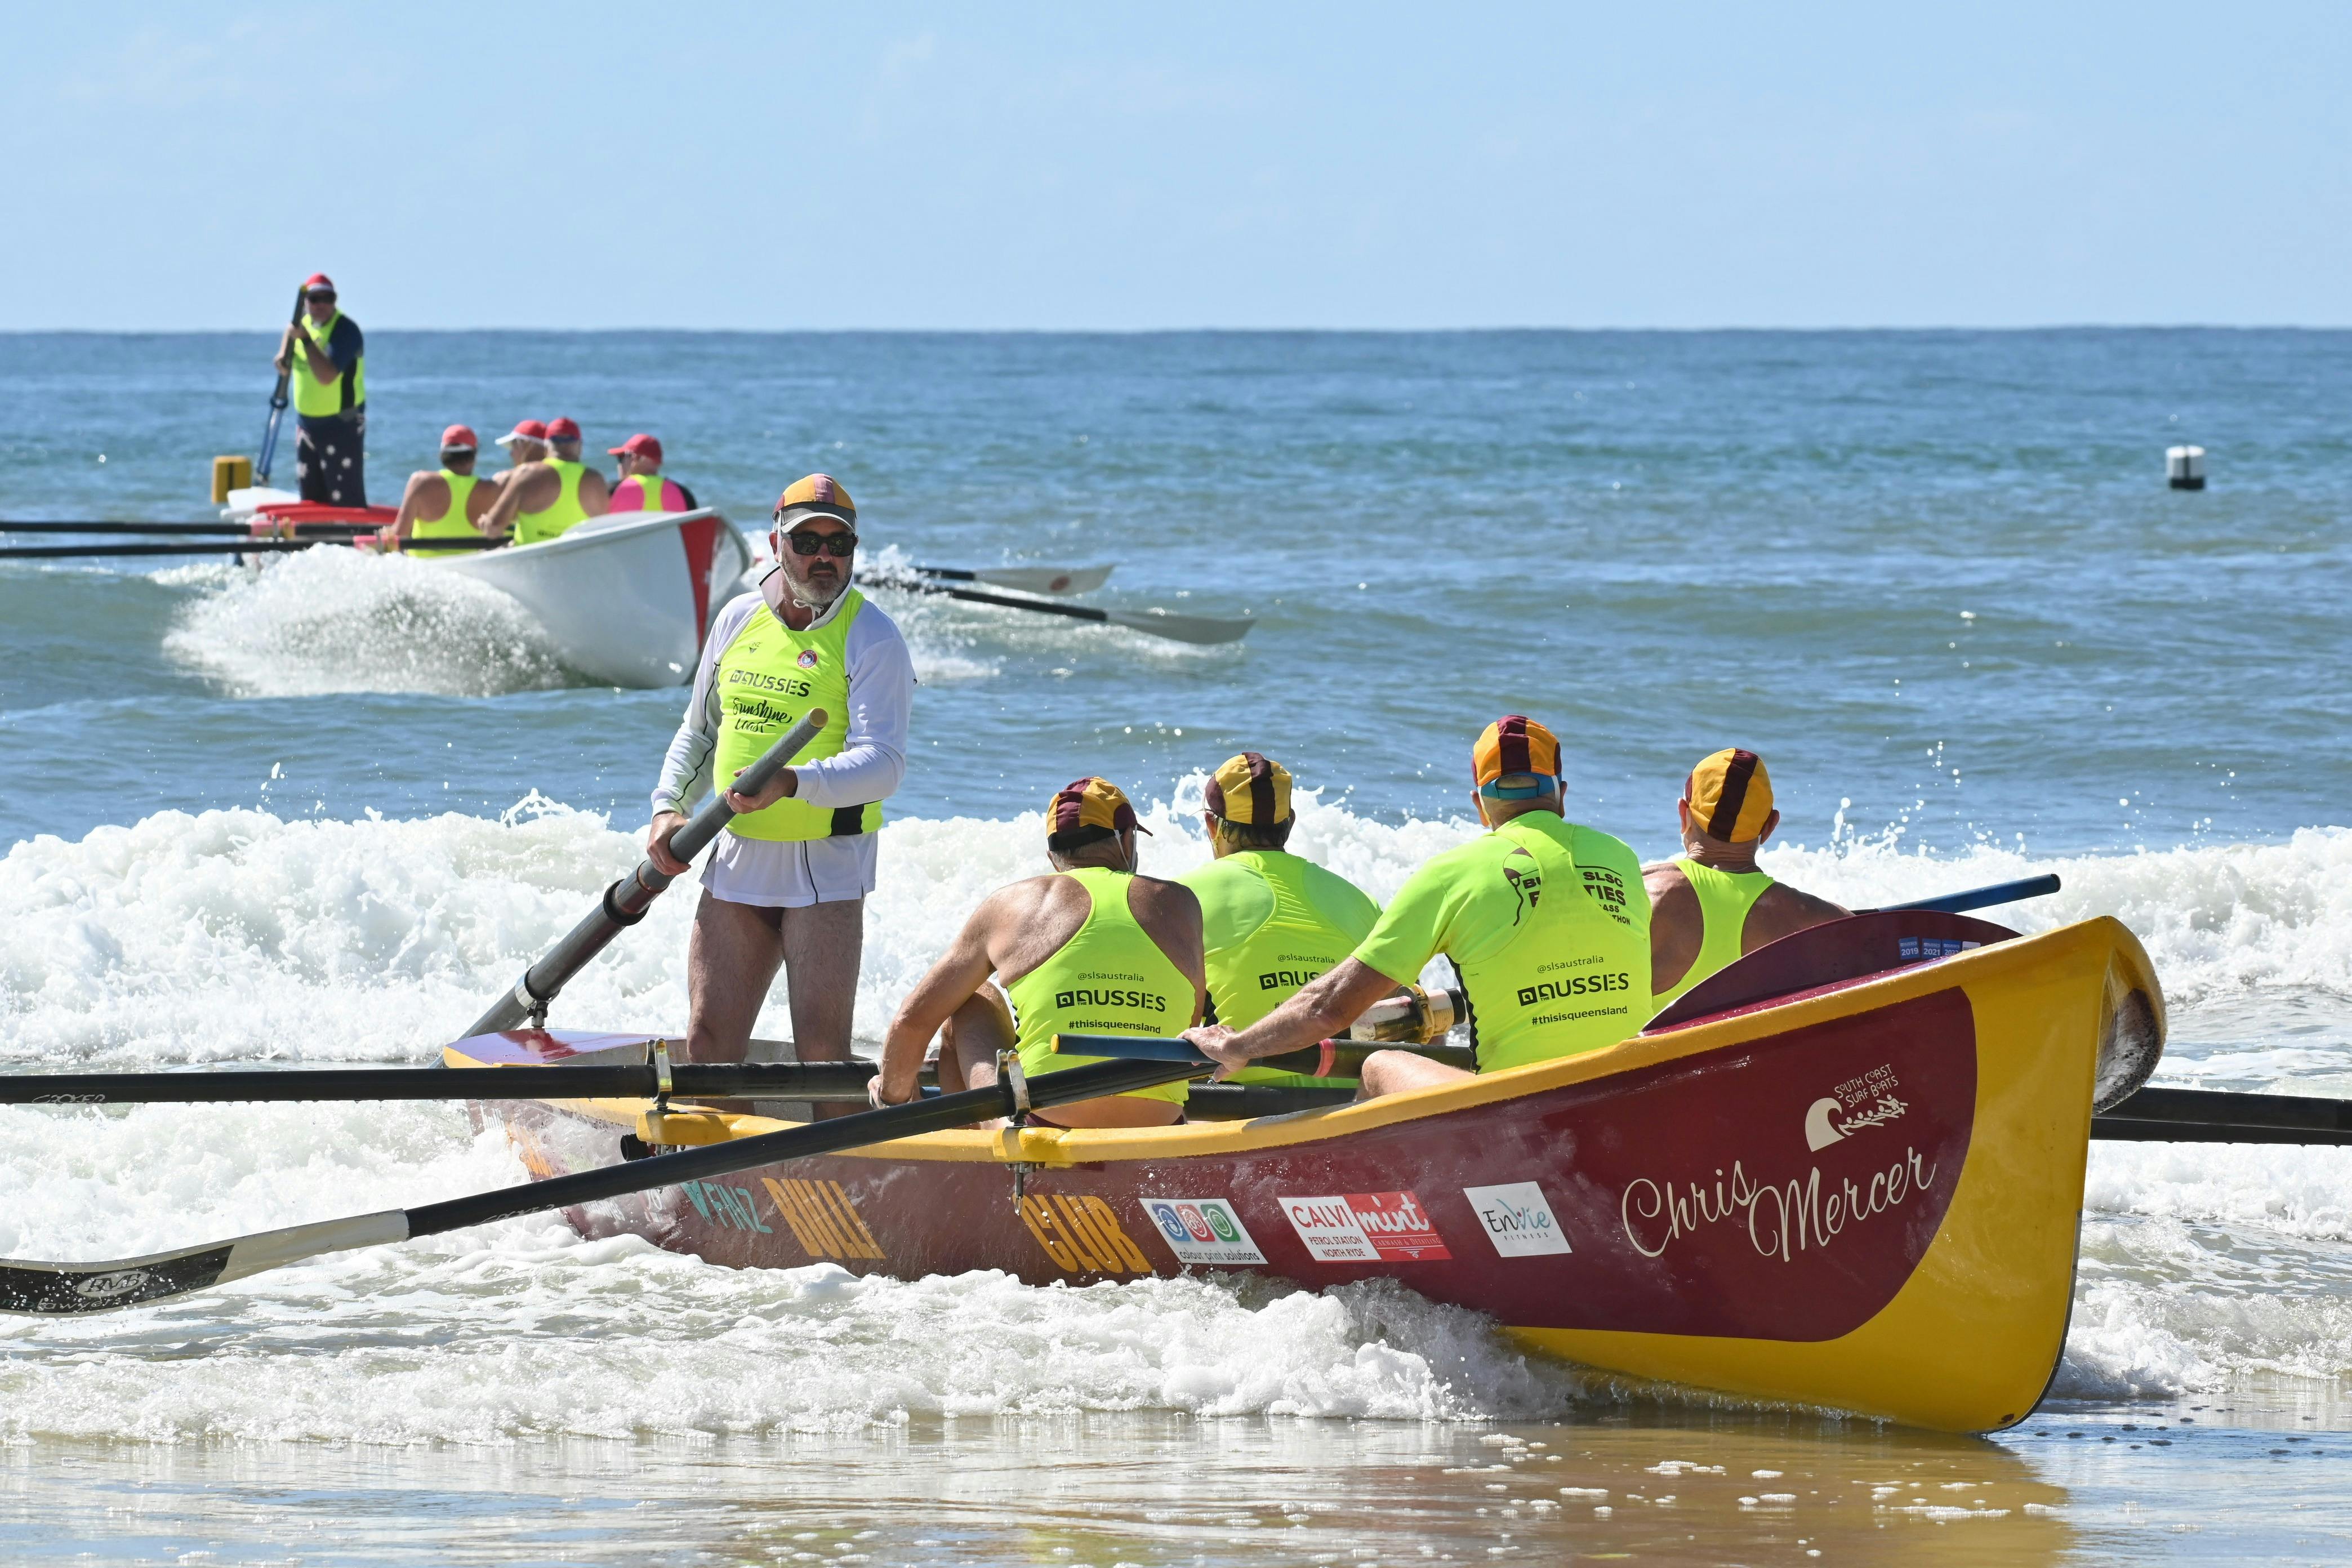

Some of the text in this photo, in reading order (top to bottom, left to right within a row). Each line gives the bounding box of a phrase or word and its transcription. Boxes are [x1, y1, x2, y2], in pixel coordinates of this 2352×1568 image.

[733, 697, 793, 723] Sunshine
[1583, 871, 1623, 888] SLSC
[1277, 953, 1335, 964] @slsaustralia
[1901, 947, 1919, 956] 2019
[1536, 955, 1605, 974] @slsaustralia
[1077, 971, 1144, 982] @slsaustralia
[1531, 1005, 1628, 1026] #thisisqueensland
[1068, 1019, 1161, 1034] #thisisqueensland
[1834, 1063, 1892, 1099] SOUTH COAST
[1845, 1075, 1899, 1108] SURF BOATS
[1355, 1193, 1430, 1232] mint
[1622, 1146, 1936, 1263] Chris Mercer
[1292, 1205, 1353, 1228] CALVI
[1012, 1193, 1153, 1273] CLUB
[1308, 1236, 1364, 1245] PETROL STATION
[1504, 1232, 1549, 1241] FITNESS
[1179, 1247, 1260, 1263] colour print solutions
[1321, 1248, 1366, 1257] NORTH RYDE
[86, 1273, 143, 1293] RMB
